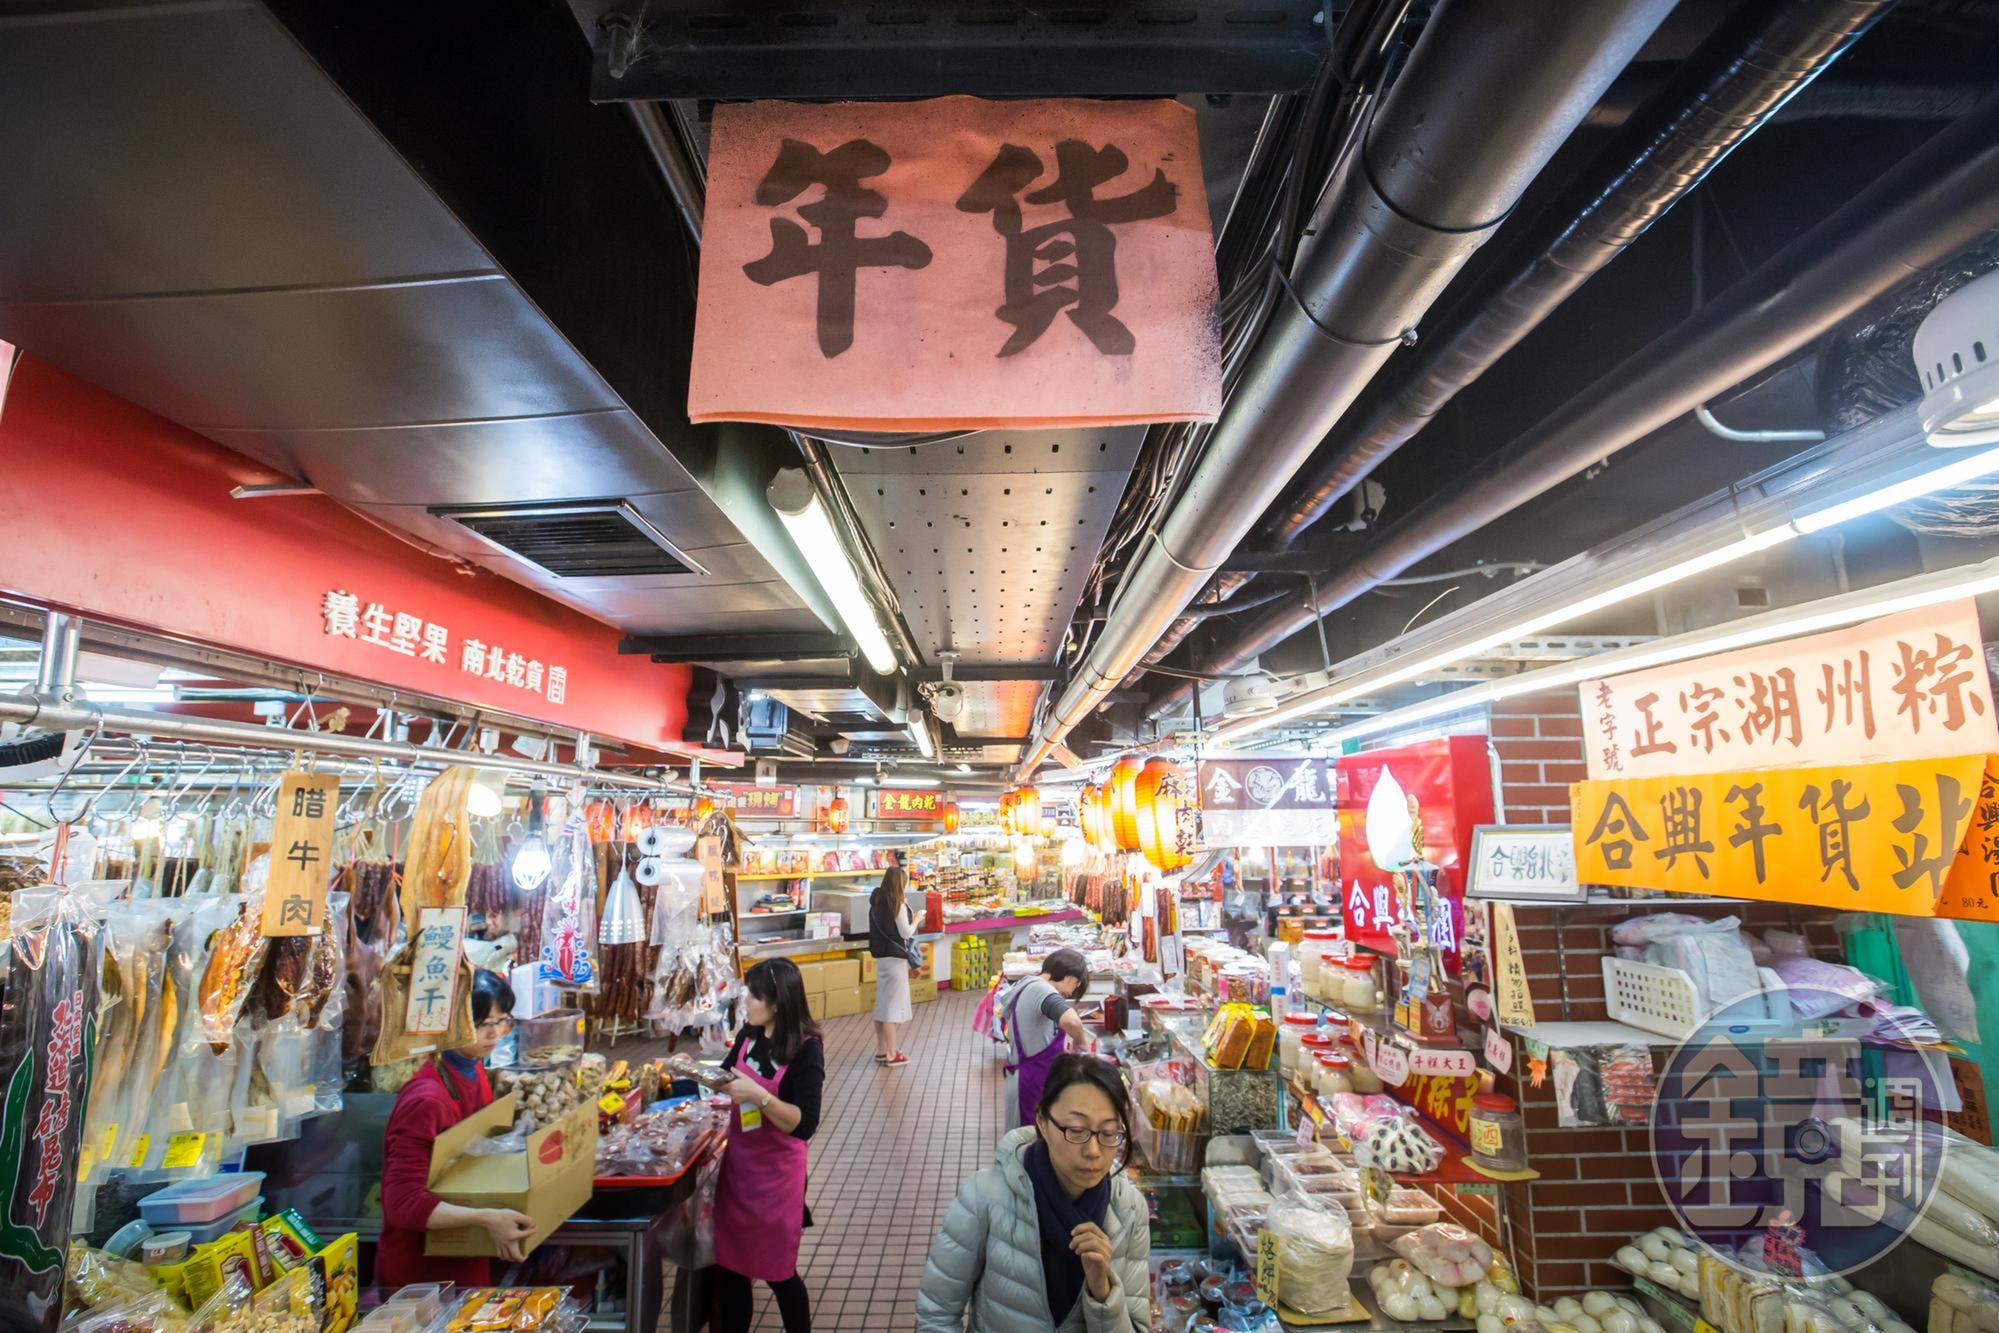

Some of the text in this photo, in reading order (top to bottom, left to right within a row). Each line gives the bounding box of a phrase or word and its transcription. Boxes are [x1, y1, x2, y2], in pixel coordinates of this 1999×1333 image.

[742, 138, 1178, 359] 年貨
[322, 589, 449, 665] 養生堅果
[462, 638, 545, 694] 南北乾貨
[1629, 632, 1985, 759] 正宗湖州粽
[1596, 681, 1624, 772] 老字號
[1585, 773, 1972, 899] 合興年貨站
[415, 924, 455, 1015] 鰻魚干
